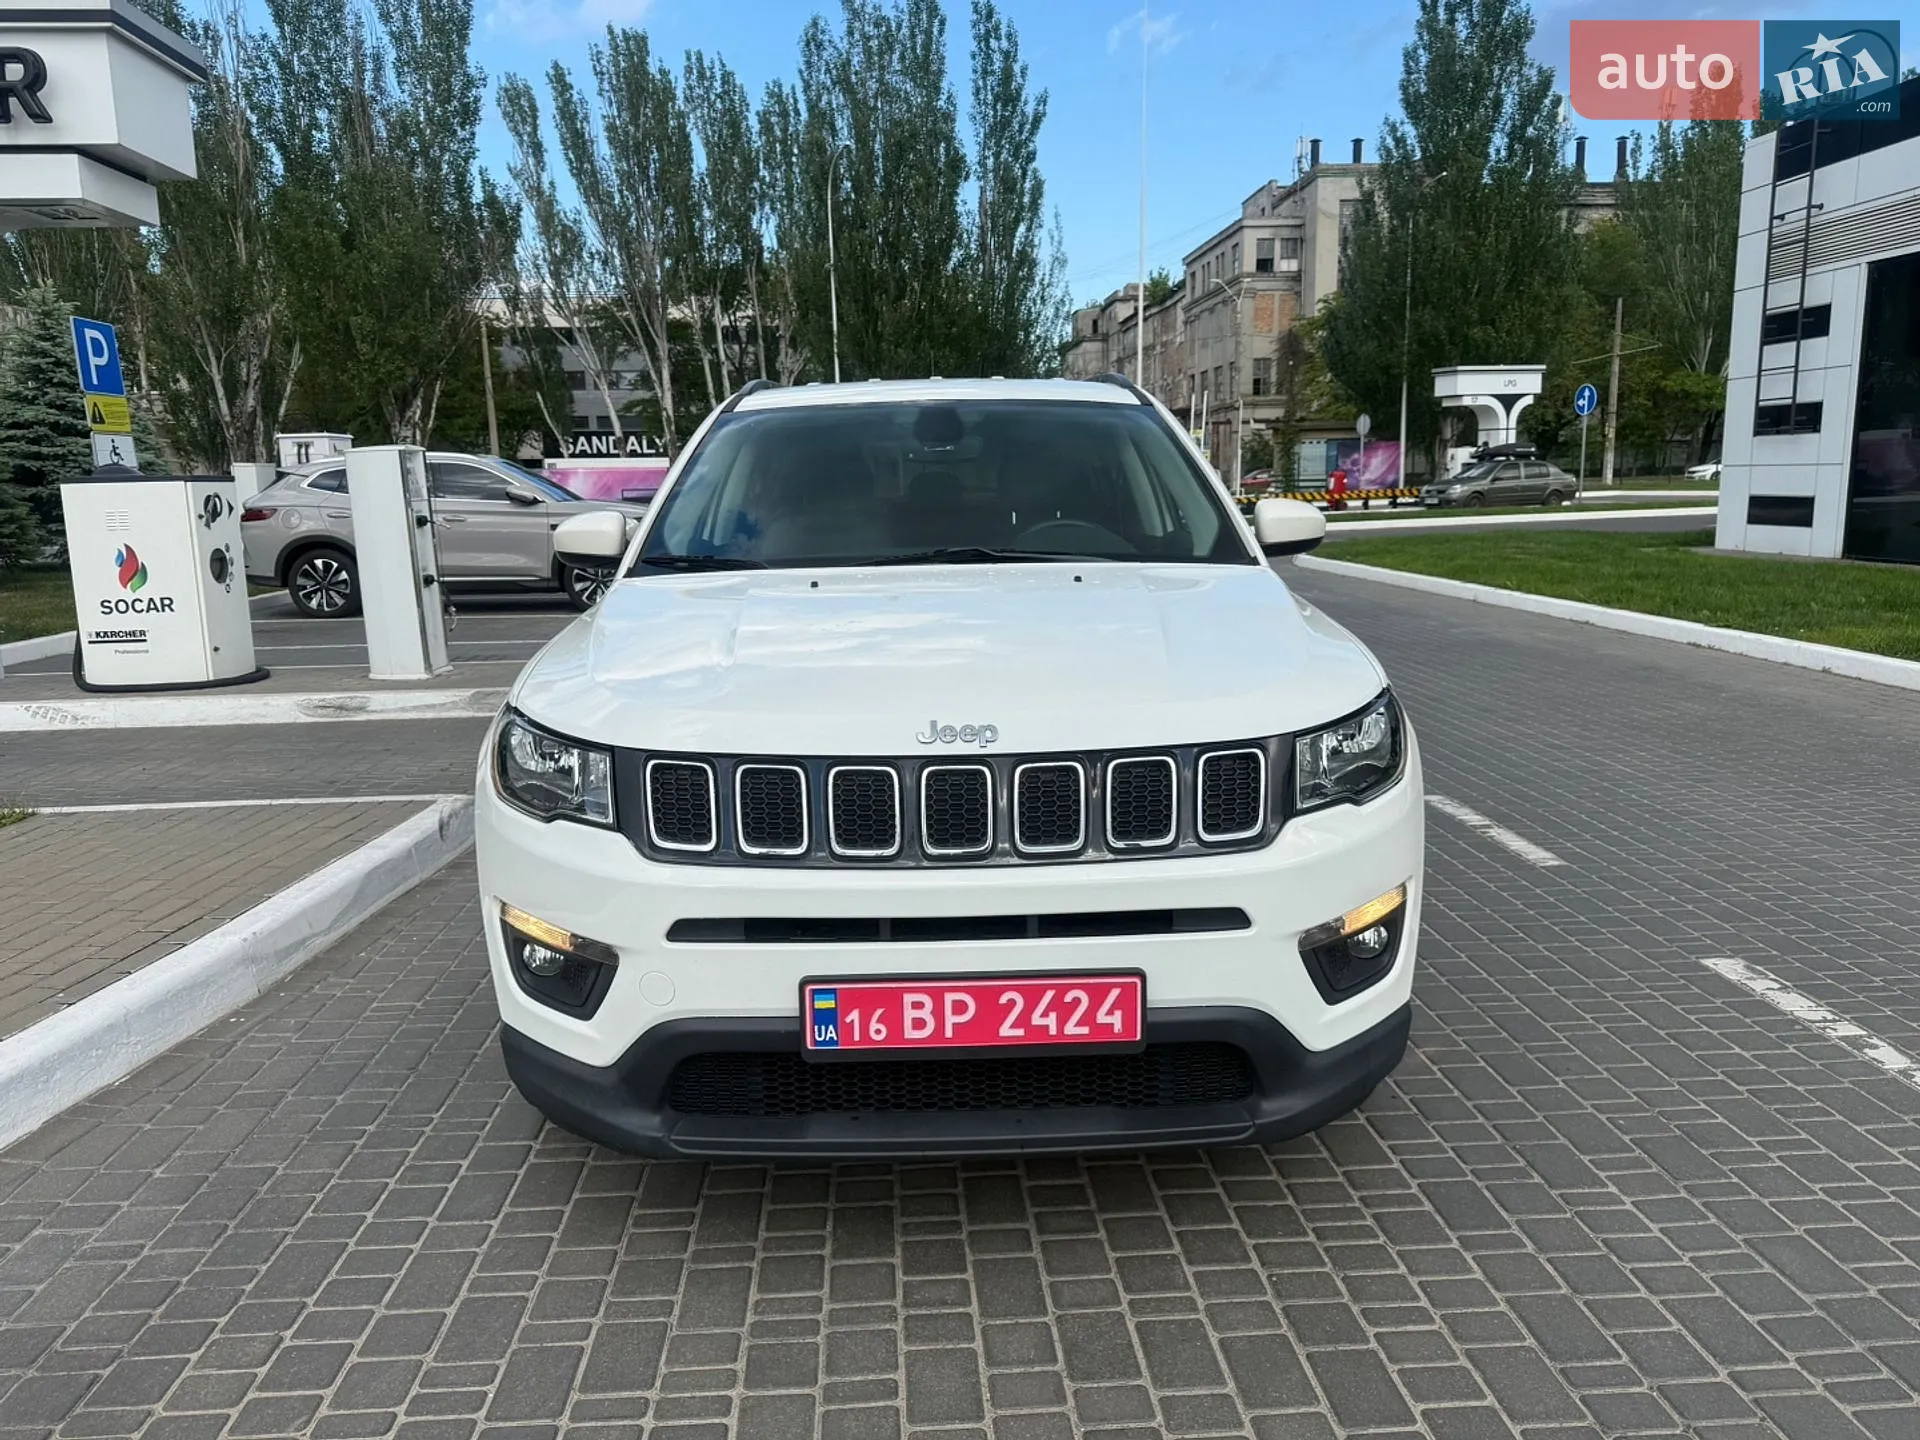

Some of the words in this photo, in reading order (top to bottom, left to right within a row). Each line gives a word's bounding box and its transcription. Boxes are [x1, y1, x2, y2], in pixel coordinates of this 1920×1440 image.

[0, 46, 54, 124] R
[84, 328, 110, 385] P
[100, 596, 175, 615] SOCAR
[915, 719, 999, 748] Jeep
[814, 1024, 838, 1042] UA
[844, 1007, 888, 1042] 16
[902, 991, 977, 1040] BP
[998, 986, 1123, 1038] 2424
